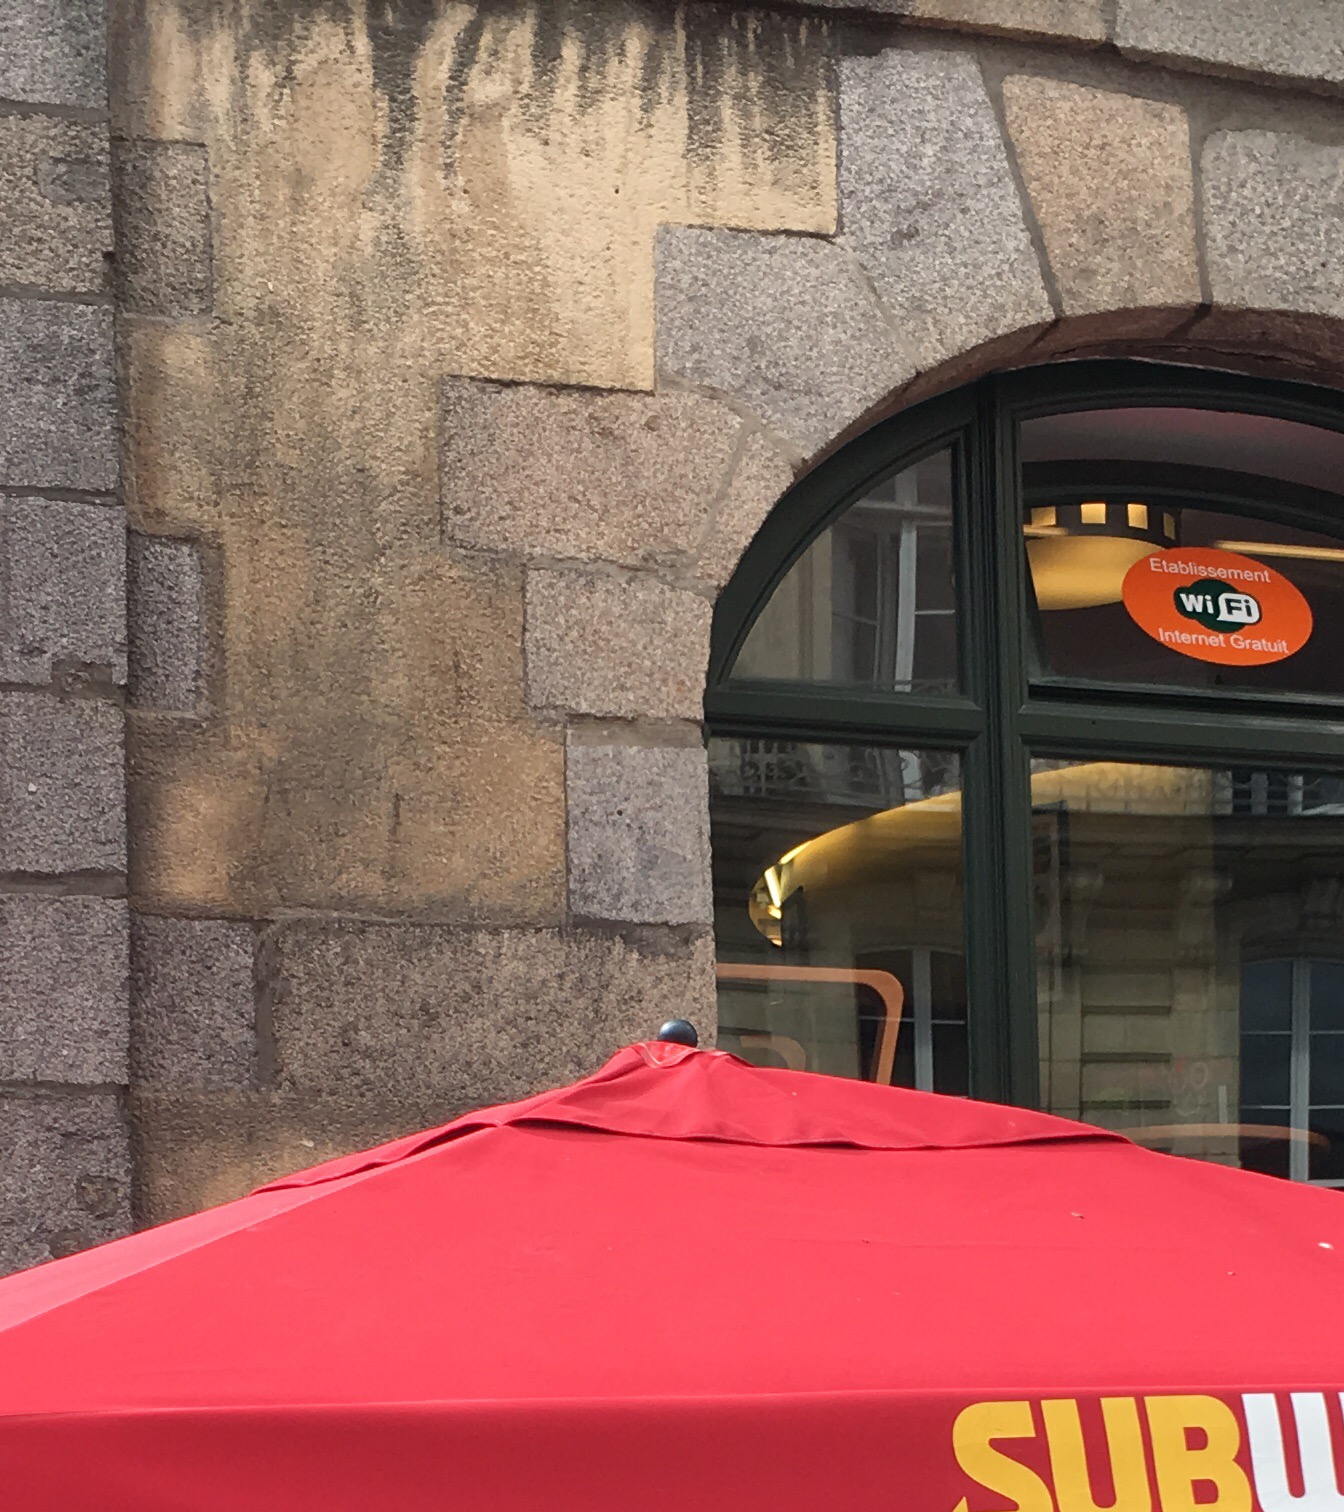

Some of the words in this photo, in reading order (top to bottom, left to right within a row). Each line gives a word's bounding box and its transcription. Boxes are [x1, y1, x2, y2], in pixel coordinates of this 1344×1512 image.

[1149, 557, 1271, 583] Etablissement
[1159, 627, 1225, 648] Internet
[1230, 634, 1289, 653] Gratuit
